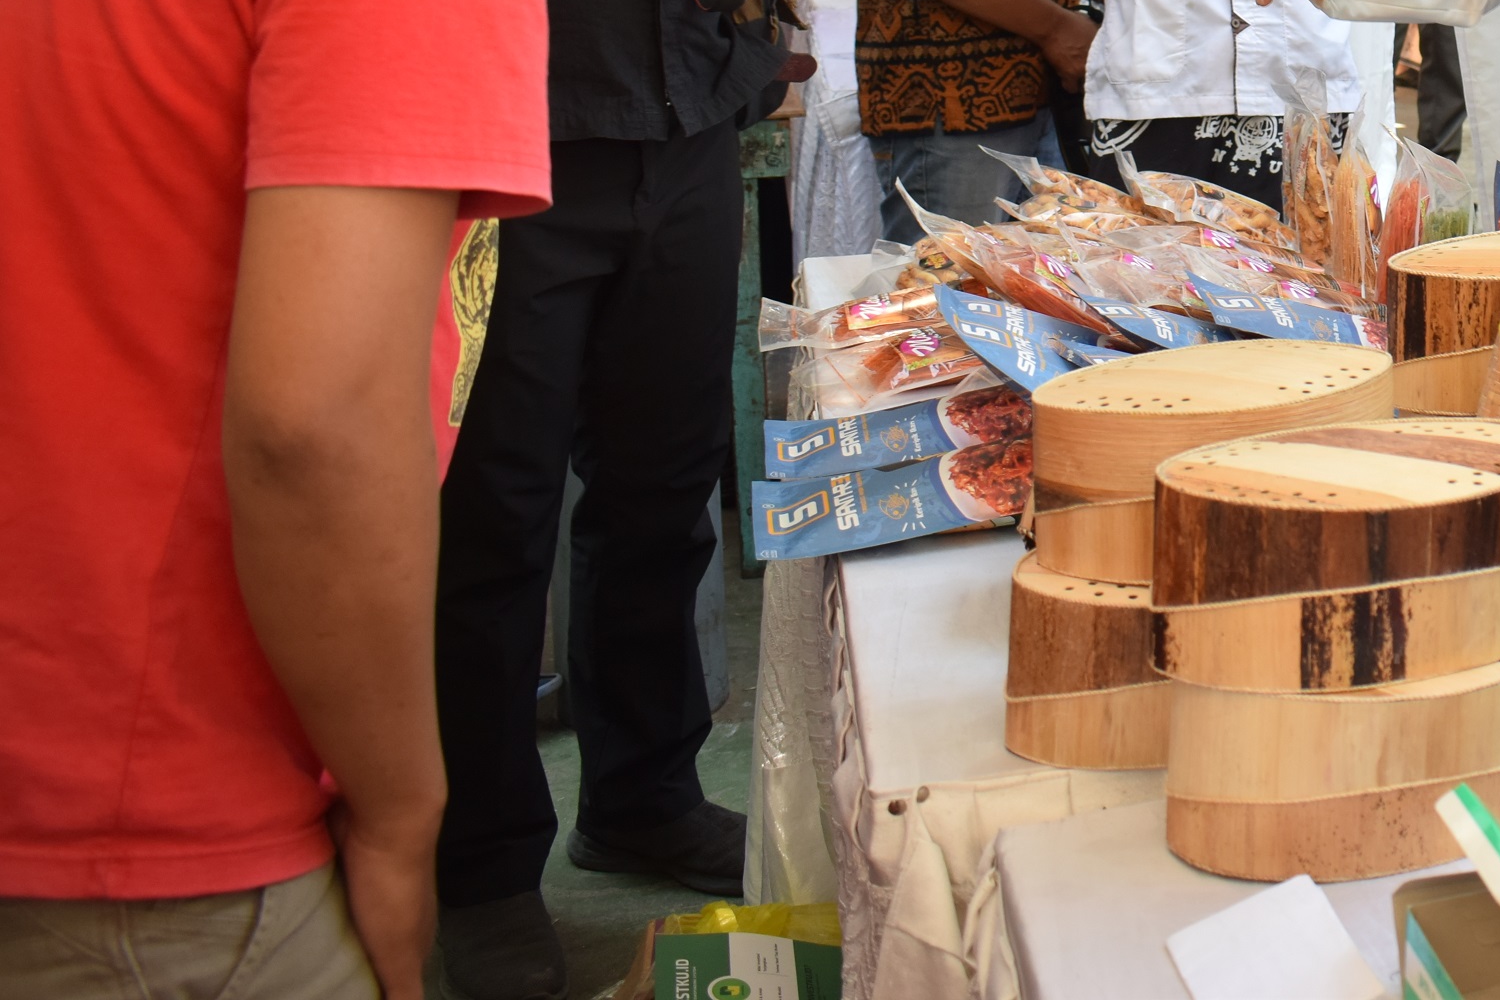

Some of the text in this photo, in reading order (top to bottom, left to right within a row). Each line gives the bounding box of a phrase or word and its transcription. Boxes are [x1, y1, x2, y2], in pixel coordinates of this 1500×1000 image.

[788, 434, 824, 458] S
[913, 432, 922, 453] Keripik
[778, 500, 818, 529] S
[914, 499, 924, 519] Keripik
